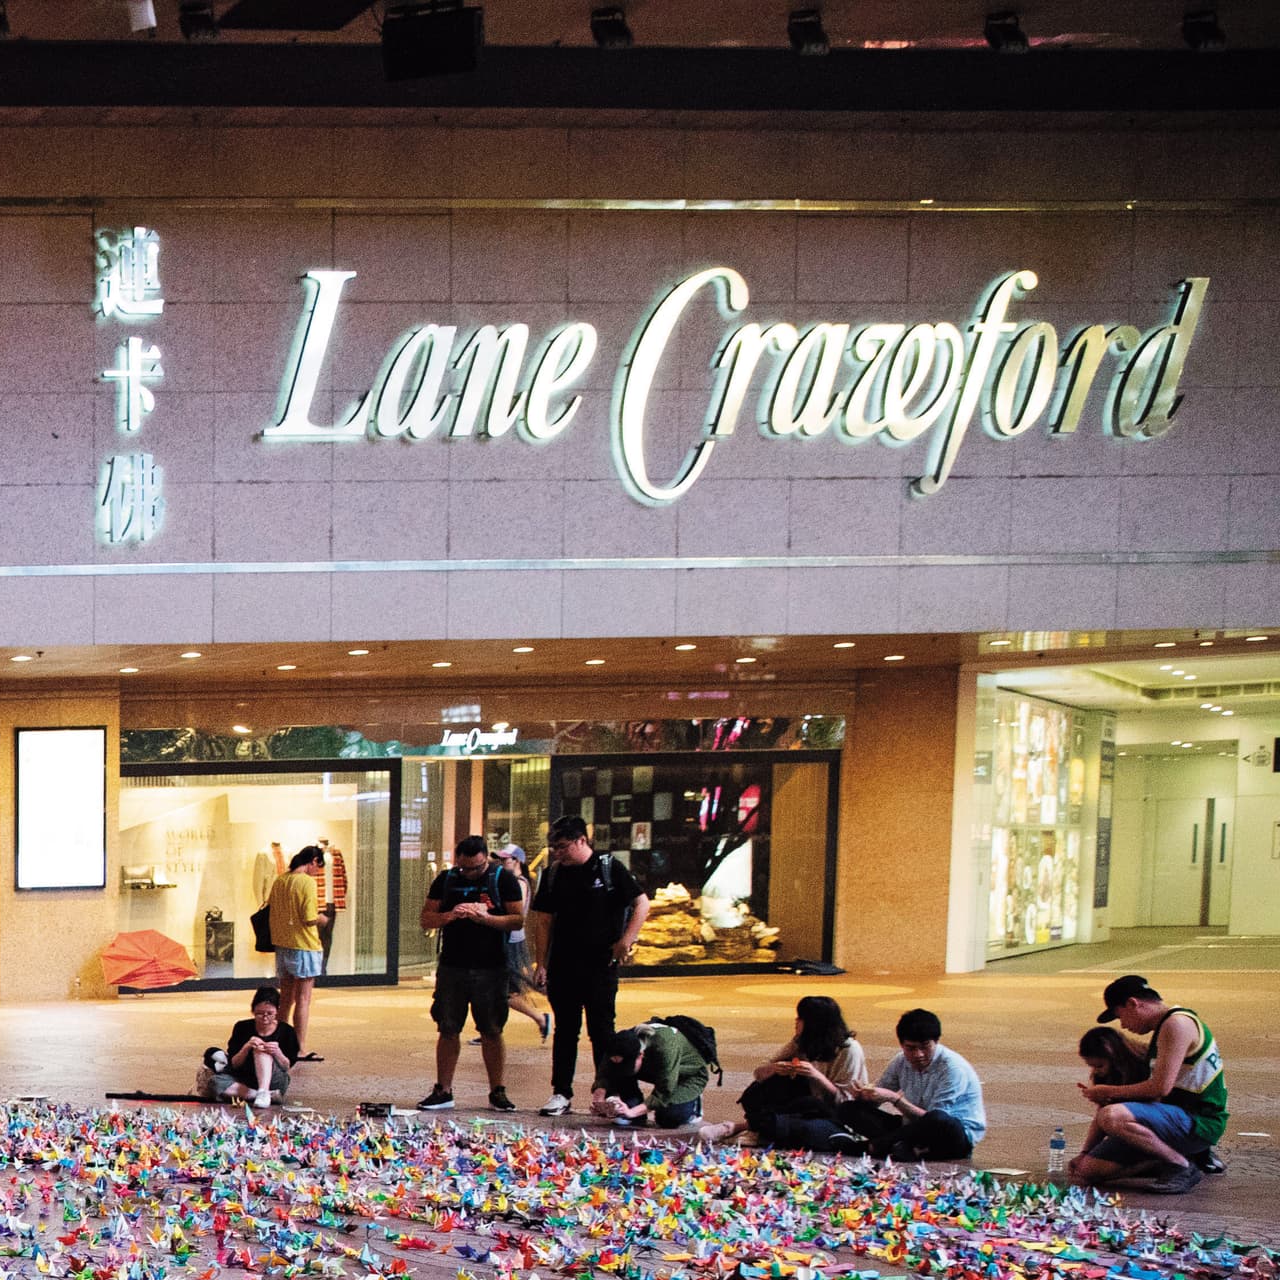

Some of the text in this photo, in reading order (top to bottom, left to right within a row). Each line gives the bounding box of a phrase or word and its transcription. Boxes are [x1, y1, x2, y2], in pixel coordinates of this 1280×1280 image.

[93, 226, 165, 543] 連卡佛
[260, 266, 1210, 502] Lane Crawford
